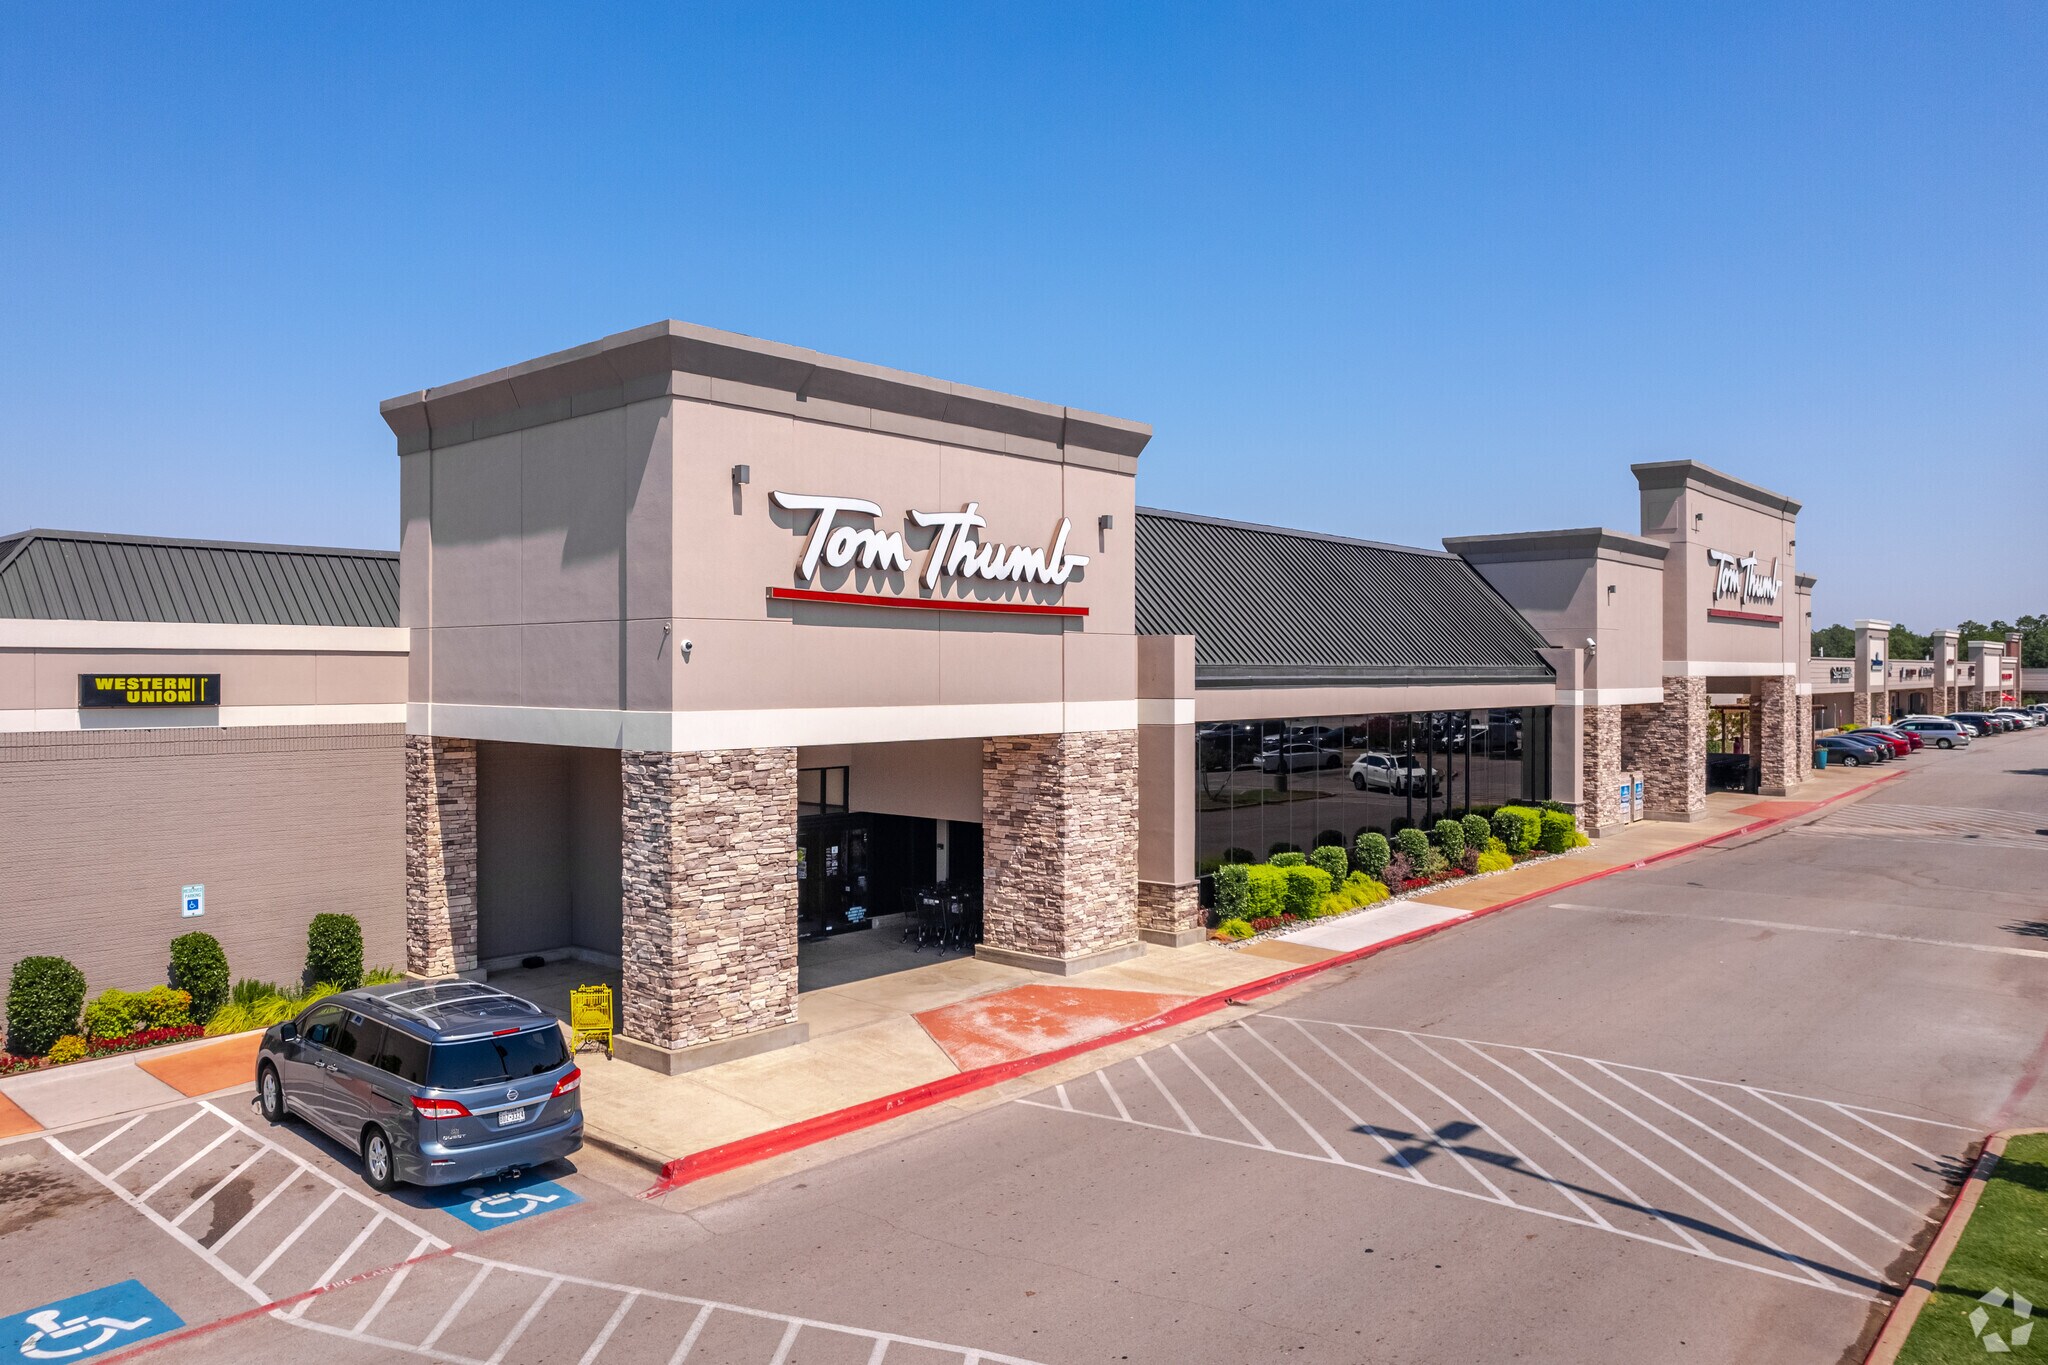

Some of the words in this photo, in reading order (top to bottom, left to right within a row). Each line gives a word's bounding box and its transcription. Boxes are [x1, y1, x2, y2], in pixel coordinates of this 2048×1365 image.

[770, 490, 912, 582] Tom
[907, 502, 1090, 590] Thumb
[1707, 548, 1740, 601] Tom
[1737, 550, 1782, 605] Thumb
[95, 677, 191, 690] WESTERN
[126, 690, 191, 703] UNION
[322, 1277, 355, 1292] FIRE
[362, 1264, 398, 1280] LANE
